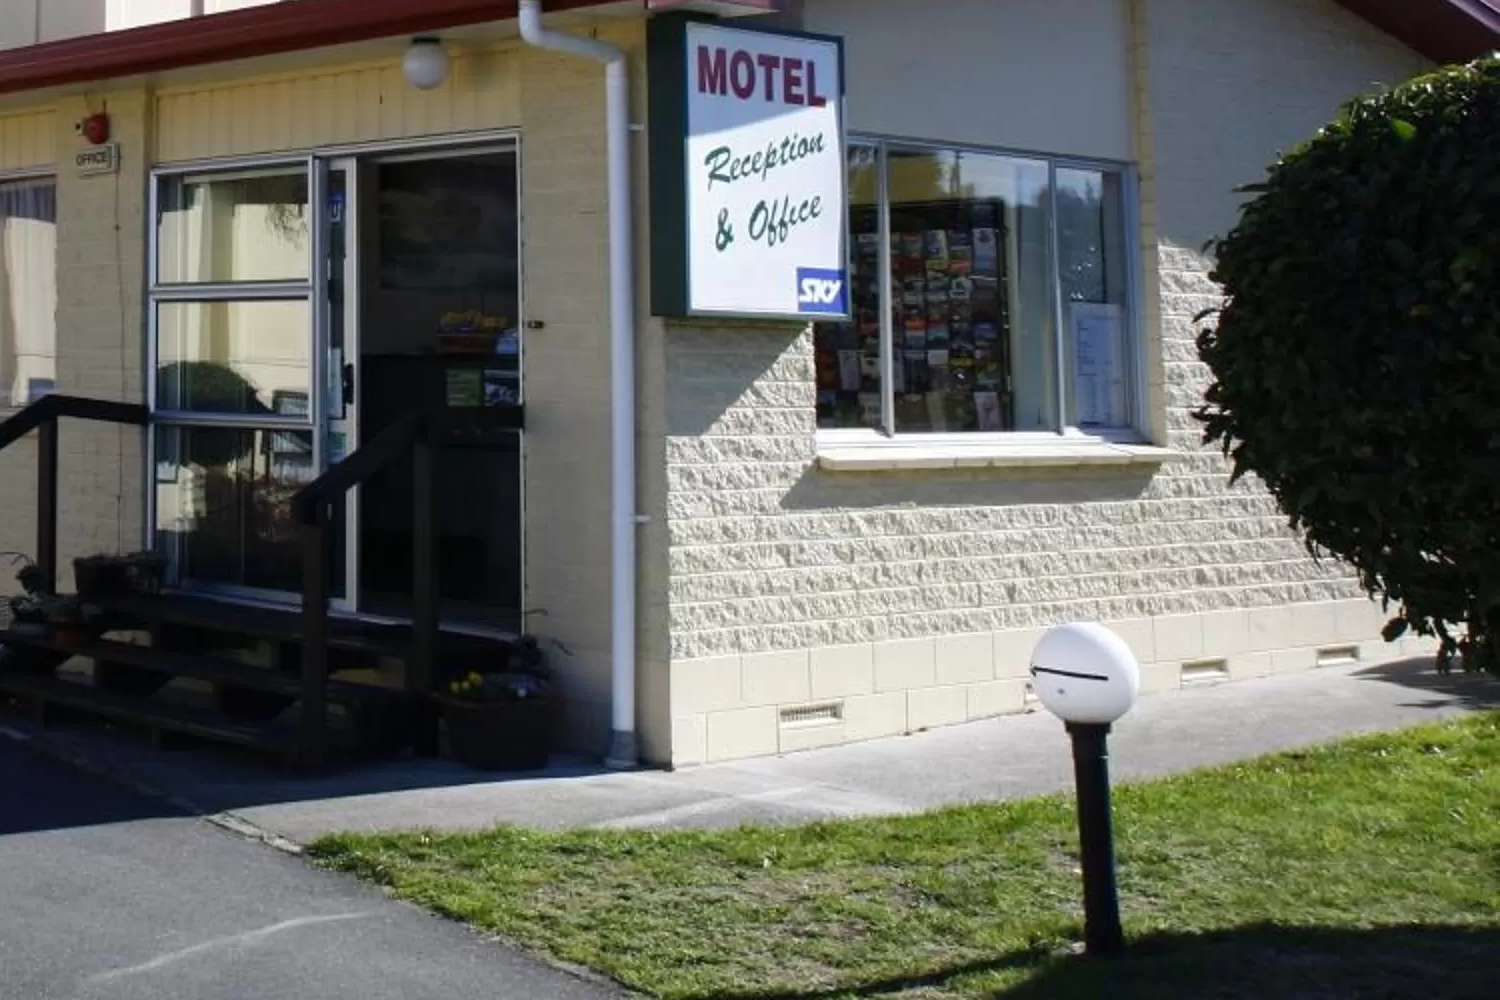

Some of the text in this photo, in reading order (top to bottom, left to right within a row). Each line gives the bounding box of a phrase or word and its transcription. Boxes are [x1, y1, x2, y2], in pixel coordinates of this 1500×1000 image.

[697, 45, 827, 107] MOTEL
[75, 151, 108, 166] OFFICE
[704, 132, 825, 191] Reception
[715, 195, 821, 251] & Office
[799, 278, 841, 304] SKY
